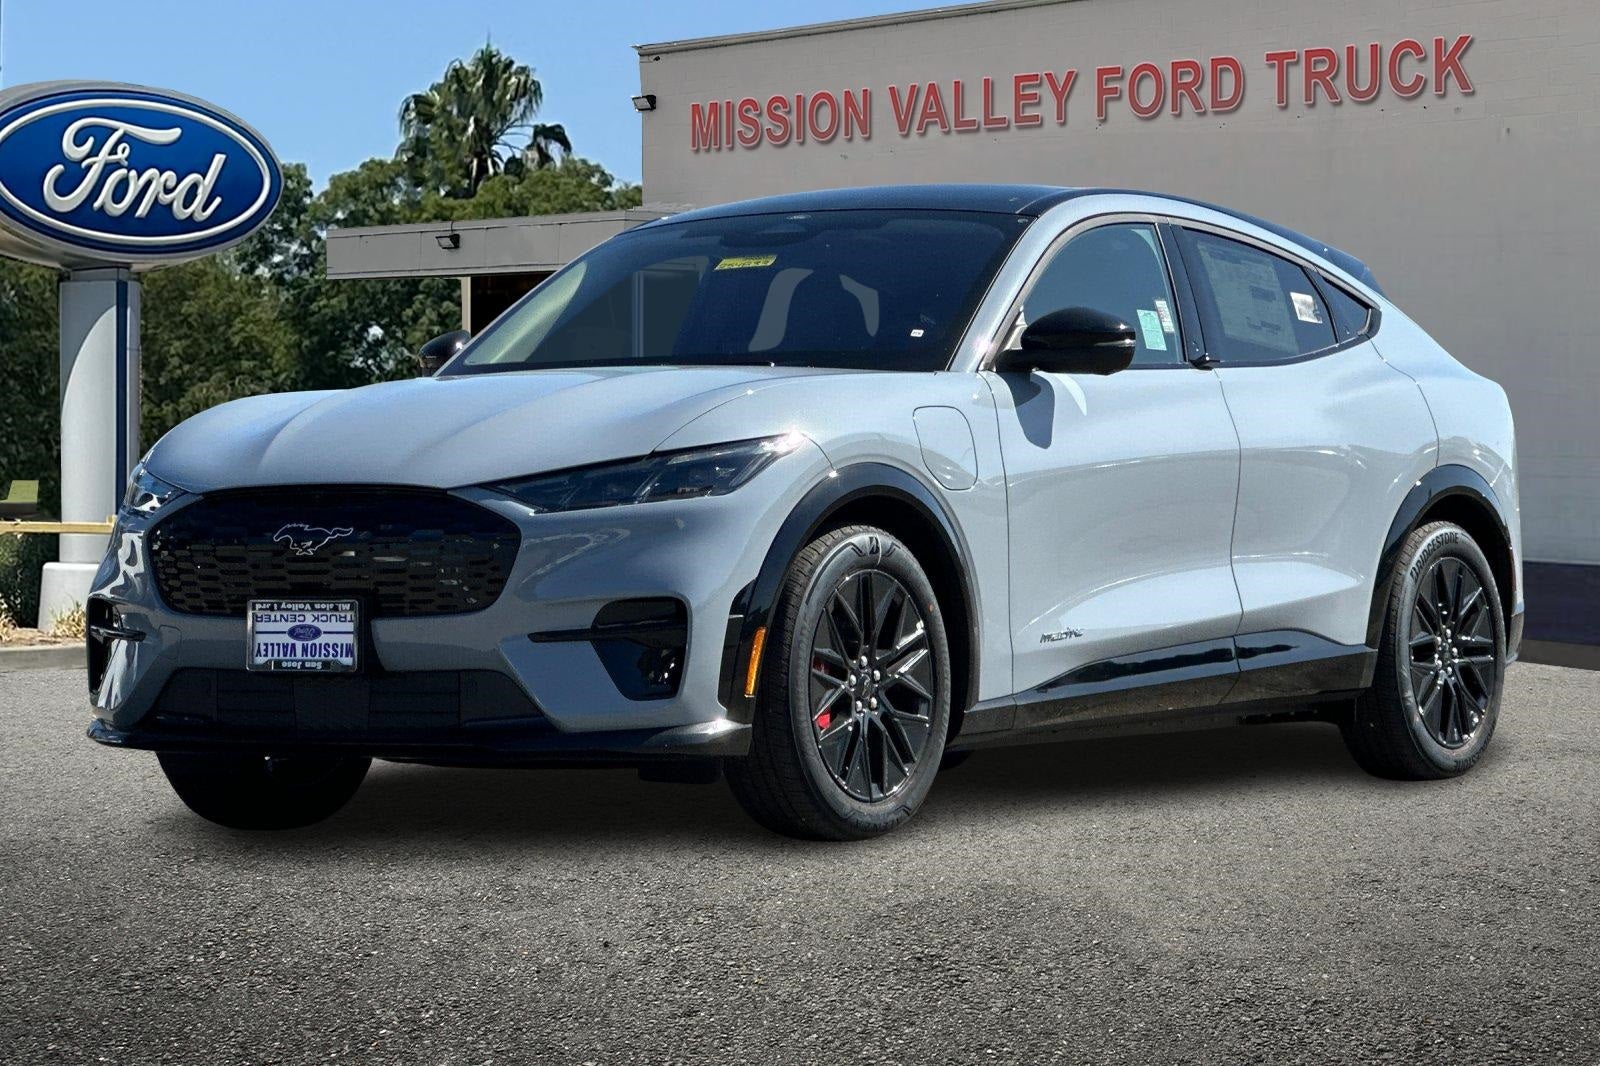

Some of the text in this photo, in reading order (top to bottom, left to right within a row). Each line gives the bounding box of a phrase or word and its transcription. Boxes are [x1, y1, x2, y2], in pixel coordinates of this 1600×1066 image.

[690, 34, 1474, 150] MISSION VALLEY FORD TRUCK
[43, 117, 227, 223] Ford
[255, 613, 354, 623] TRUCK CENTER
[255, 643, 354, 658] MISSION VALLEY
[305, 661, 323, 669] San
